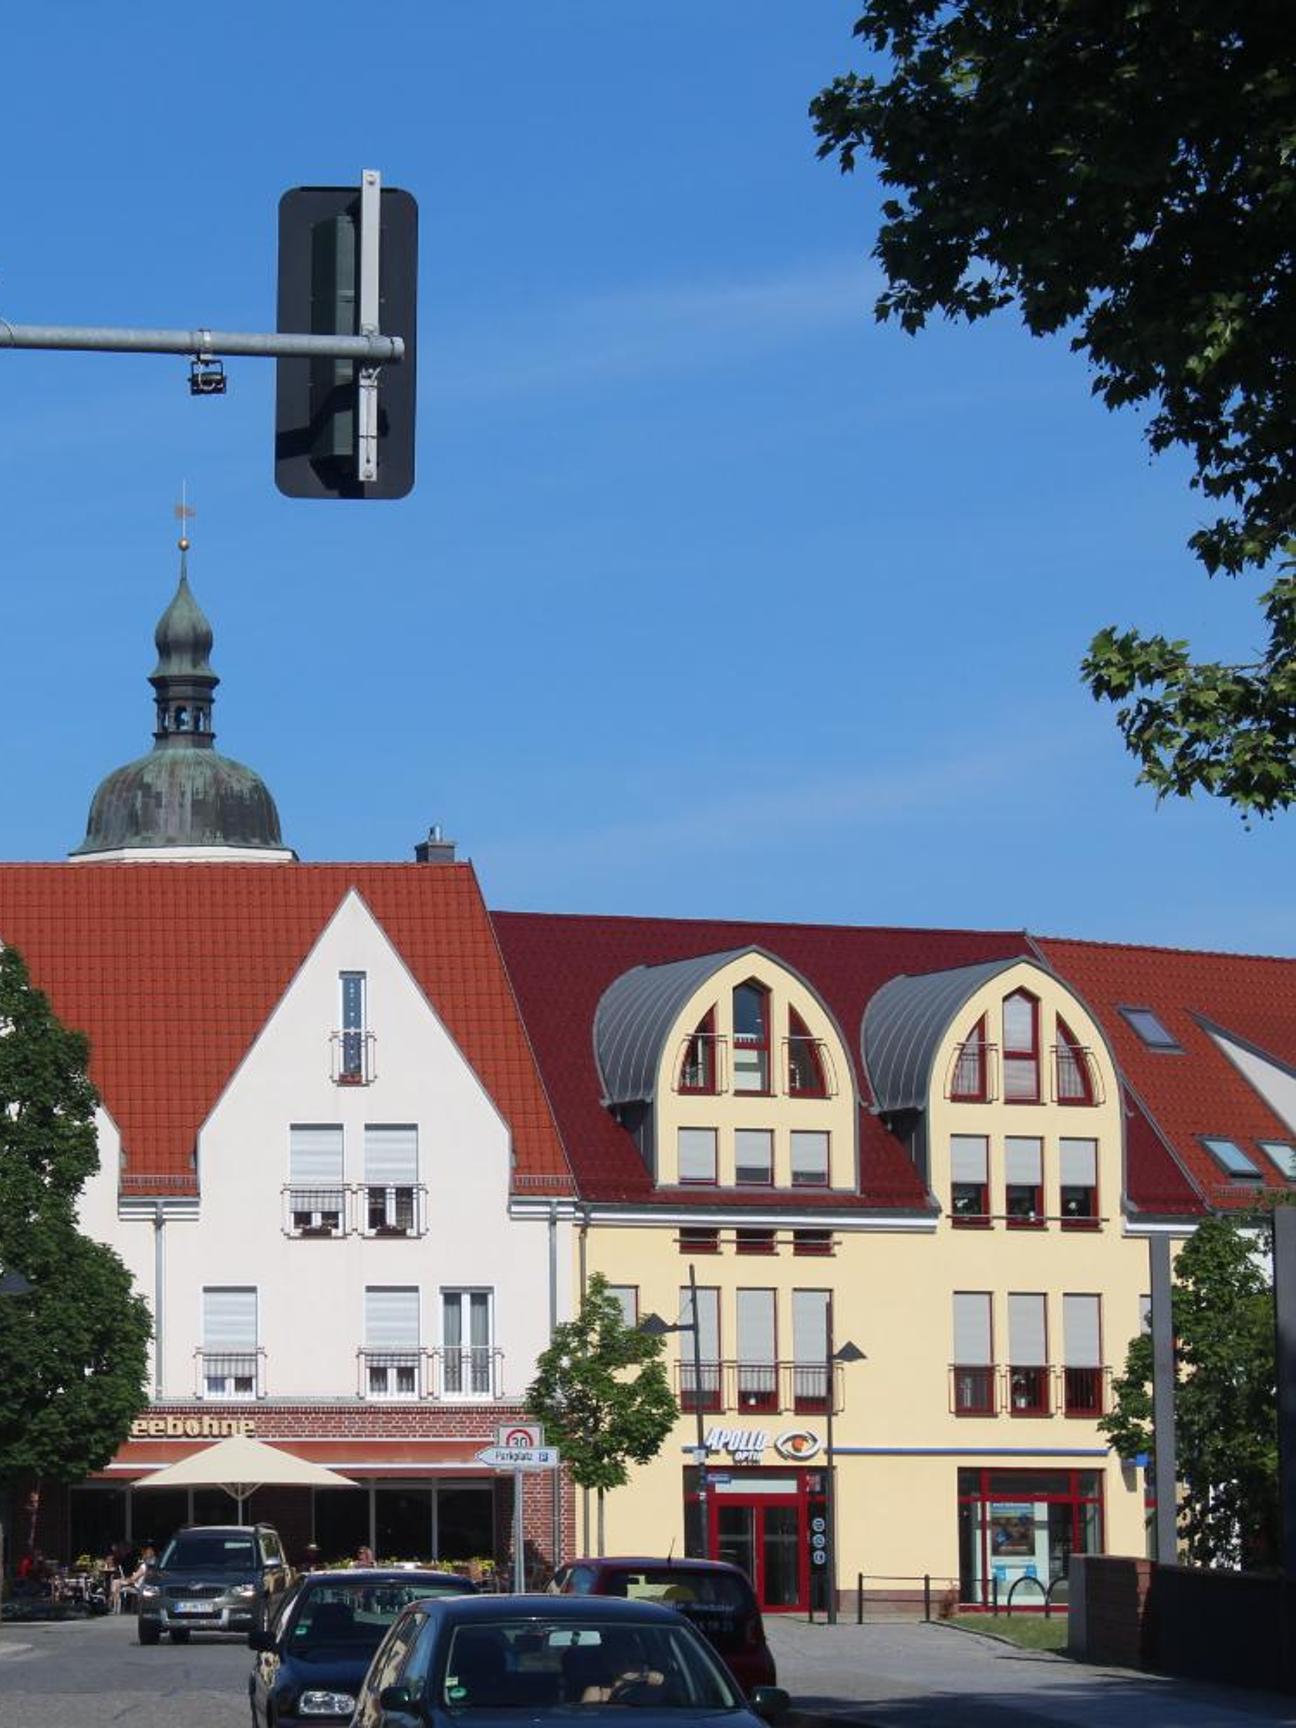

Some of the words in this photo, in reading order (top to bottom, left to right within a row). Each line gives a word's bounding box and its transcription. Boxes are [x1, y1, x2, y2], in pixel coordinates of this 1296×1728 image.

[131, 1416, 256, 1437] eebohne
[512, 1437, 528, 1448] 30
[705, 1429, 766, 1451] APOLLO
